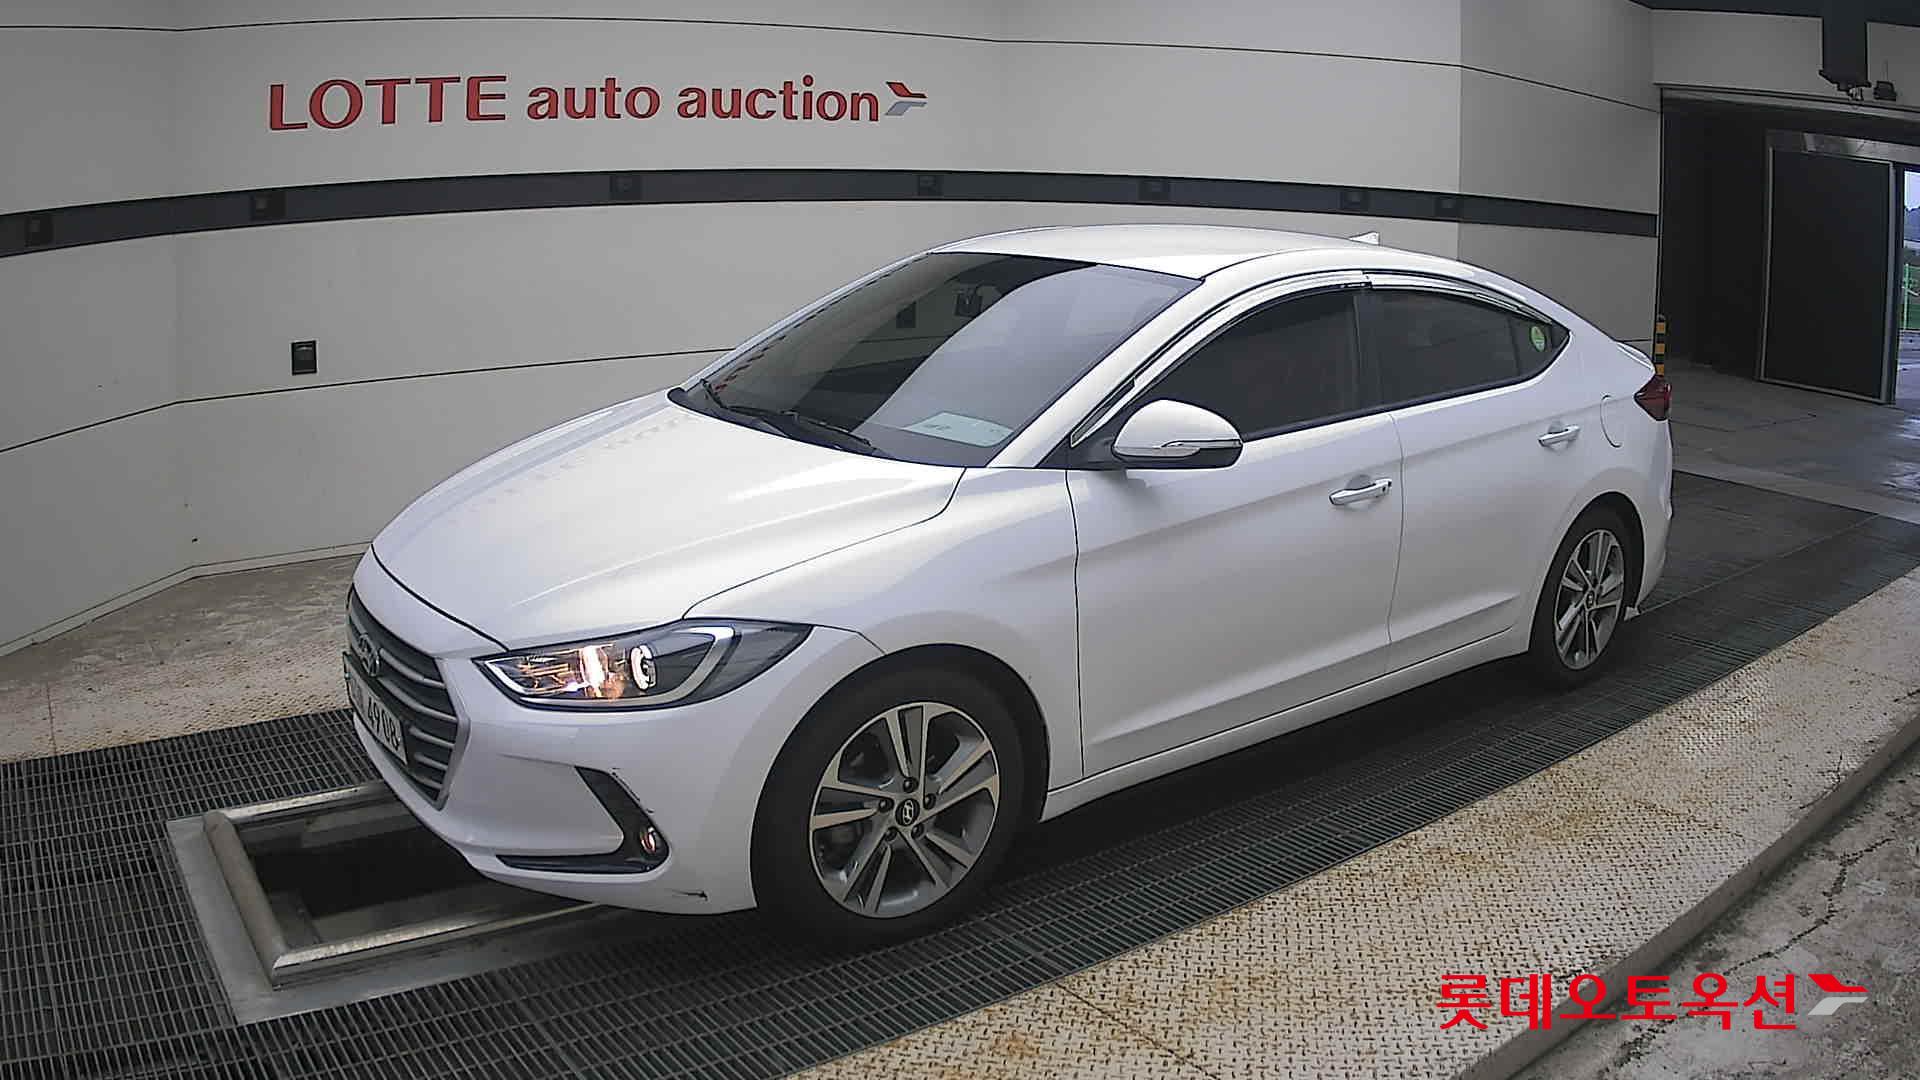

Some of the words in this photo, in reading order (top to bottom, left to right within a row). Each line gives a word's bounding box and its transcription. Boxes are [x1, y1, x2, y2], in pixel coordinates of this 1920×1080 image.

[269, 75, 508, 131] LOTTE
[526, 77, 662, 121] auto
[677, 74, 881, 123] auction
